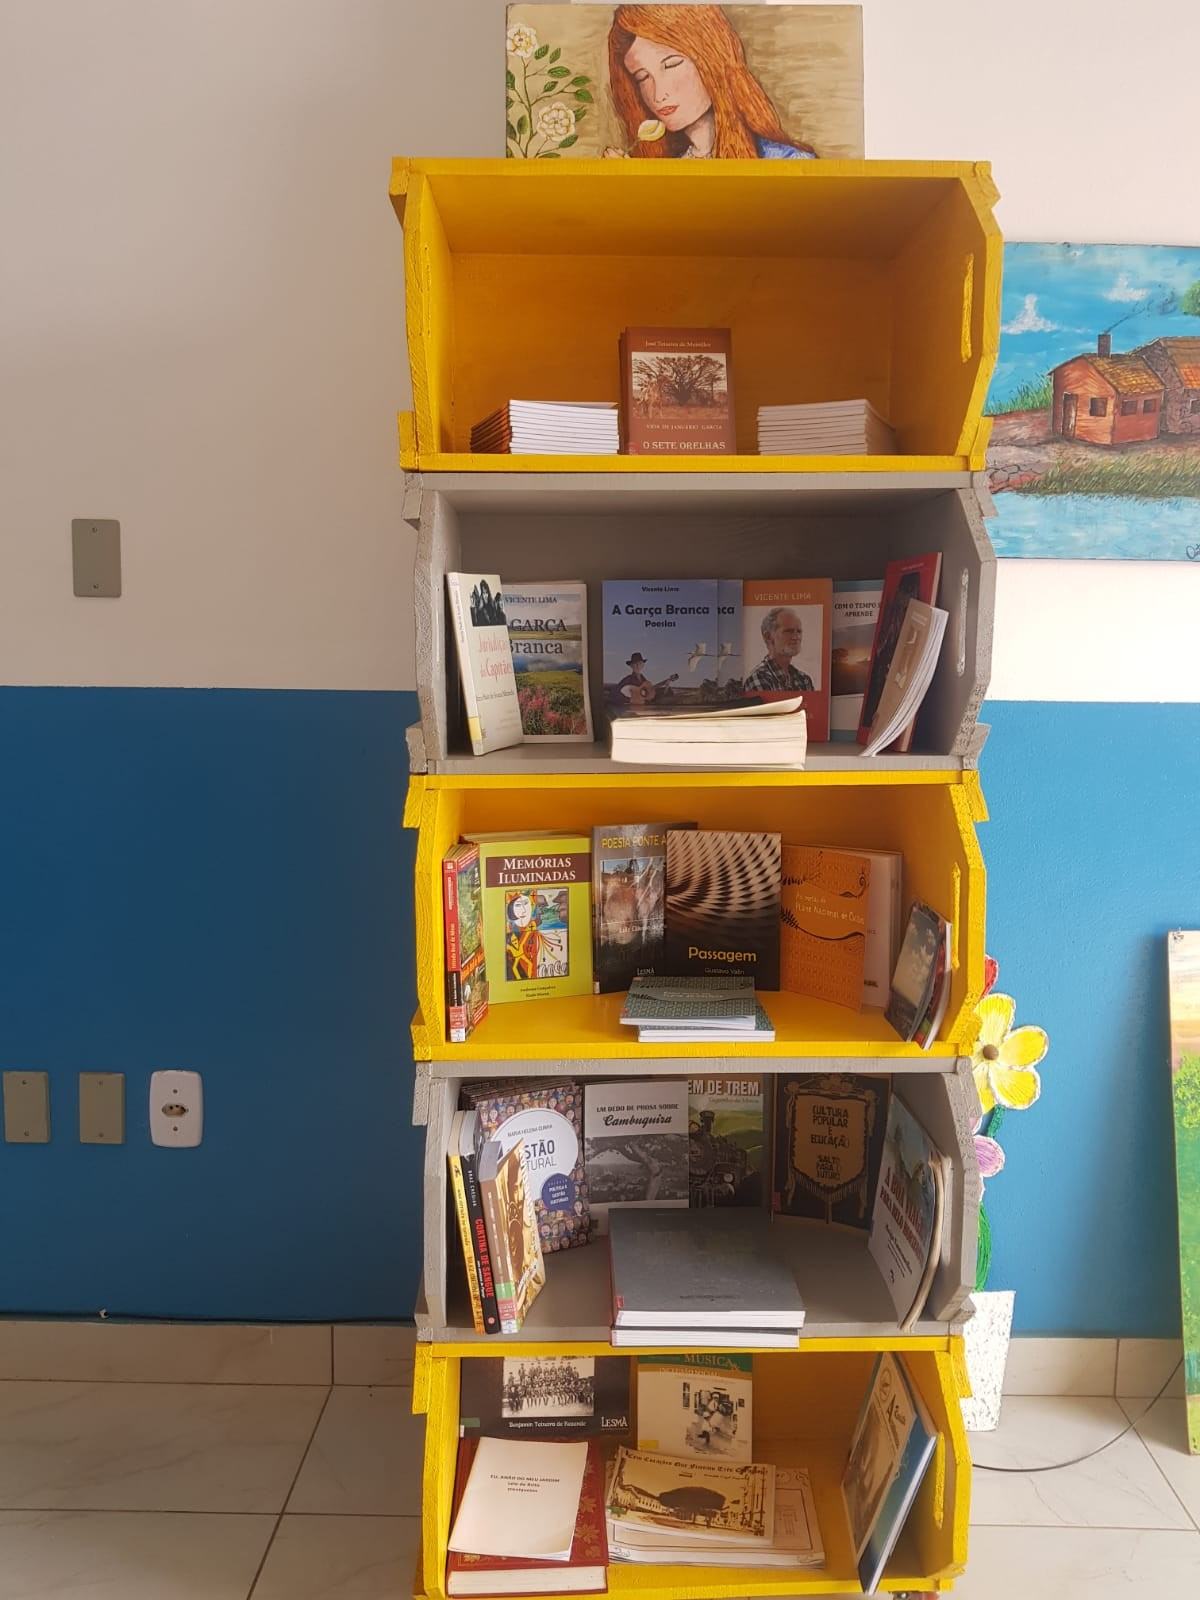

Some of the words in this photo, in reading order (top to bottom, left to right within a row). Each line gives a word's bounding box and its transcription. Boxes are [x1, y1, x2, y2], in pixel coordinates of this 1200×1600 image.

[643, 441, 650, 449] O
[652, 441, 677, 449] SETE
[680, 441, 726, 450] ORELHAS
[505, 596, 537, 604] VICENTE
[754, 593, 788, 601] VICENTE
[791, 592, 813, 600] LIMA
[612, 605, 622, 615] A
[625, 605, 662, 618] Garça
[666, 604, 710, 615] Branca
[510, 618, 568, 635] GARÇA
[645, 620, 677, 628] Poesias
[602, 836, 631, 849] POESIA
[632, 835, 660, 847] PONTE
[503, 856, 572, 871] MEMÓRIAS
[499, 870, 576, 884] ILUMINADAS
[688, 946, 757, 962] Passagem
[707, 1080, 722, 1095] DE
[727, 1080, 760, 1096] TREM
[812, 1105, 849, 1118] CULTURA
[812, 1115, 848, 1128] POPULAR
[828, 1127, 833, 1135] E
[475, 1218, 489, 1254] CORTINA
[480, 1255, 490, 1266] DE
[482, 1266, 494, 1298] SANGUE
[601, 1416, 628, 1428] LESMA
